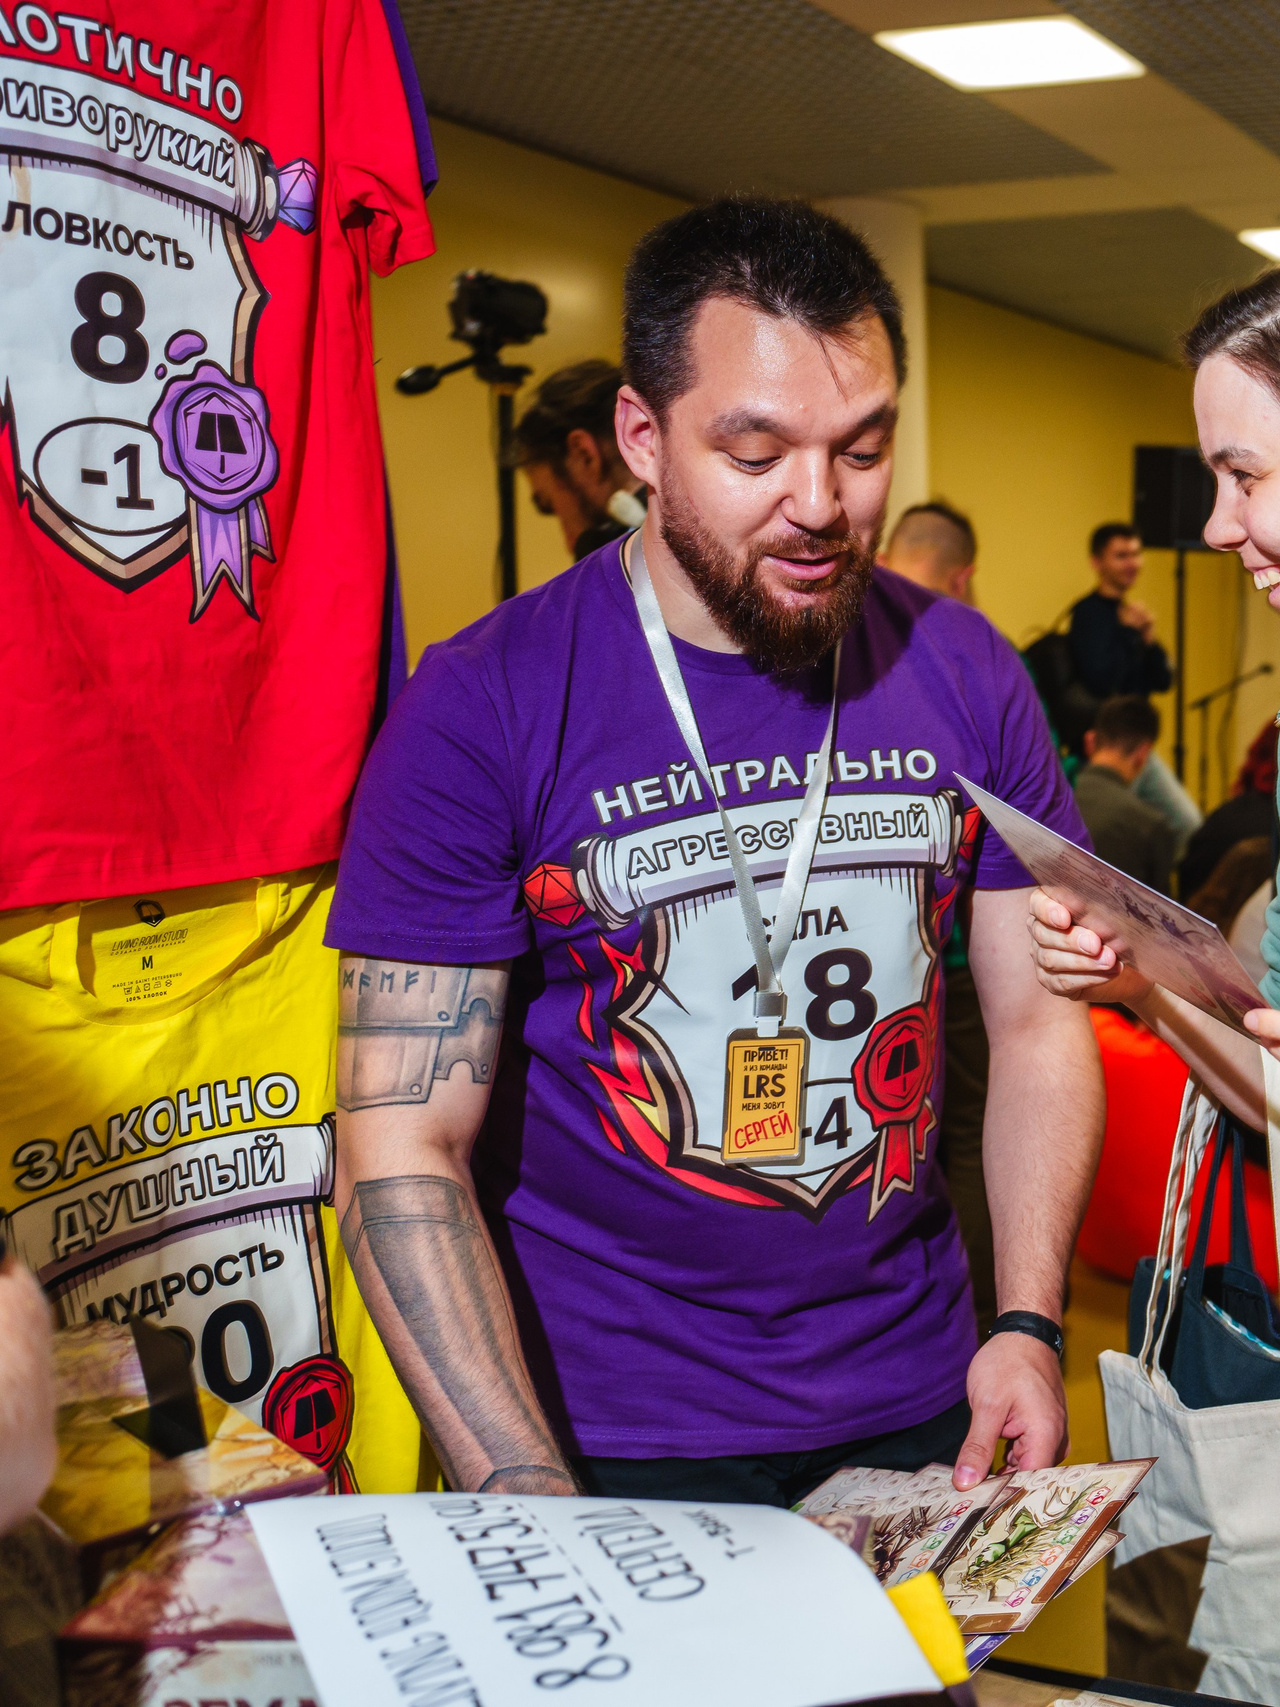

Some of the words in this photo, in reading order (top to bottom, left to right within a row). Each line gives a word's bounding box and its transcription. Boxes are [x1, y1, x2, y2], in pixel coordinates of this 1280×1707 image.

[0, 78, 236, 188] иворукий
[2, 201, 194, 271] ЛОВКОСТЬ
[70, 271, 150, 384] 8
[81, 443, 154, 511] -1
[627, 803, 930, 879] АГРЕССВНЫЙ
[112, 939, 139, 951] LIVING
[139, 934, 162, 946] ROOM
[162, 929, 188, 942] STUDIO
[747, 906, 849, 943] ЛА
[142, 955, 154, 970] M
[743, 1048, 789, 1062] ПРИВЕТ!
[743, 1073, 786, 1099] LRS
[760, 1063, 788, 1071] КОМАНДЫ
[12, 1071, 300, 1191] ЗАКОННО
[734, 1110, 793, 1149] СЕРГЕЙ
[741, 1102, 761, 1111] МЕНЯ
[763, 1101, 785, 1110] ЗОВУТ
[52, 1132, 285, 1261] ДУШНЫЙ
[86, 1243, 285, 1325] МУДРОСТЬ
[574, 1505, 705, 1602] СЕРГЕЙ
[380, 1631, 484, 1707] IVING
[535, 1653, 641, 1690] 8
